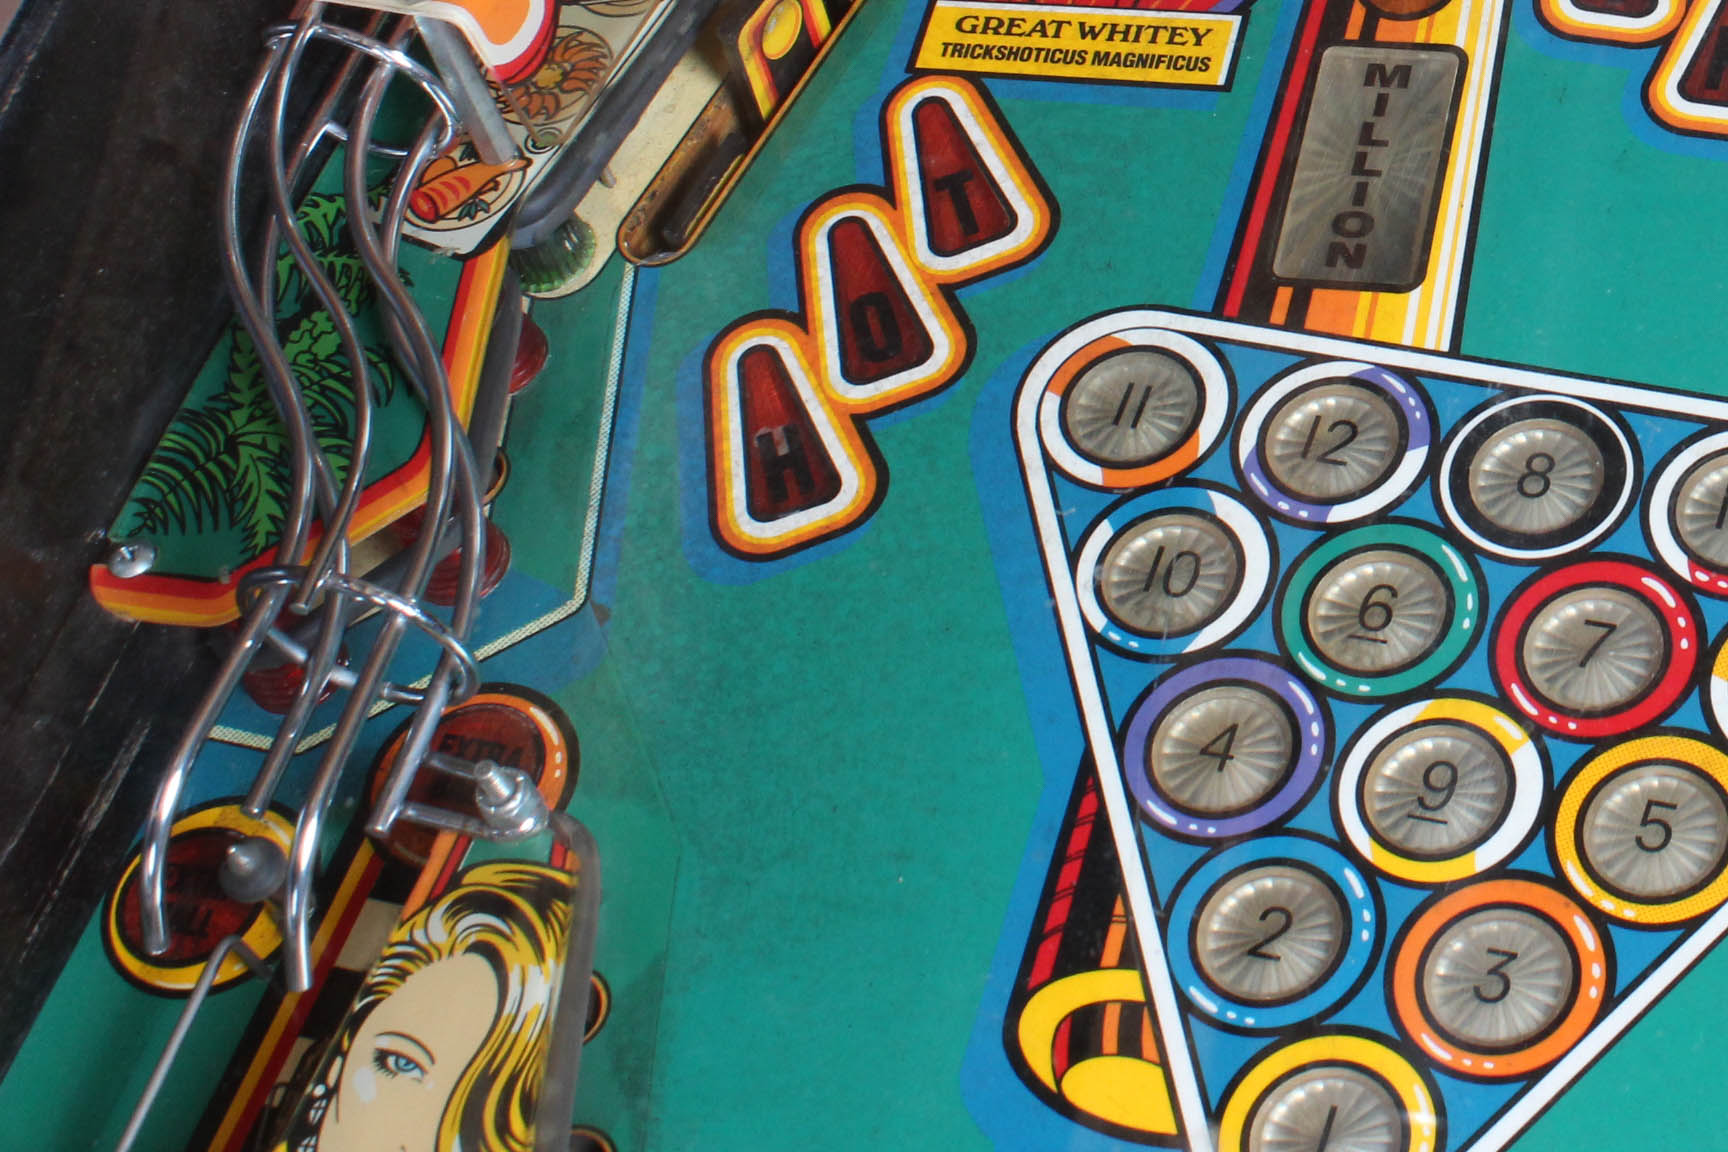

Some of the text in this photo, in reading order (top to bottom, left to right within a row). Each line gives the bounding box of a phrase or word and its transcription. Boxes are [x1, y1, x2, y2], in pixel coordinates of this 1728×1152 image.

[940, 41, 1212, 73] TRICKSHOTICUS MAGNIFICUS
[954, 14, 1215, 47] GREAT WHITEY
[1112, 381, 1153, 430] 11
[1300, 414, 1360, 467] 12
[1517, 452, 1556, 499] 8
[1143, 544, 1201, 599] 10
[1349, 584, 1399, 644] 6
[1579, 618, 1618, 669] 7
[1199, 722, 1239, 773] 4
[1407, 759, 1460, 825] 9
[1633, 798, 1678, 853] 5
[1246, 904, 1294, 963] 2
[1472, 947, 1520, 1004] 3
